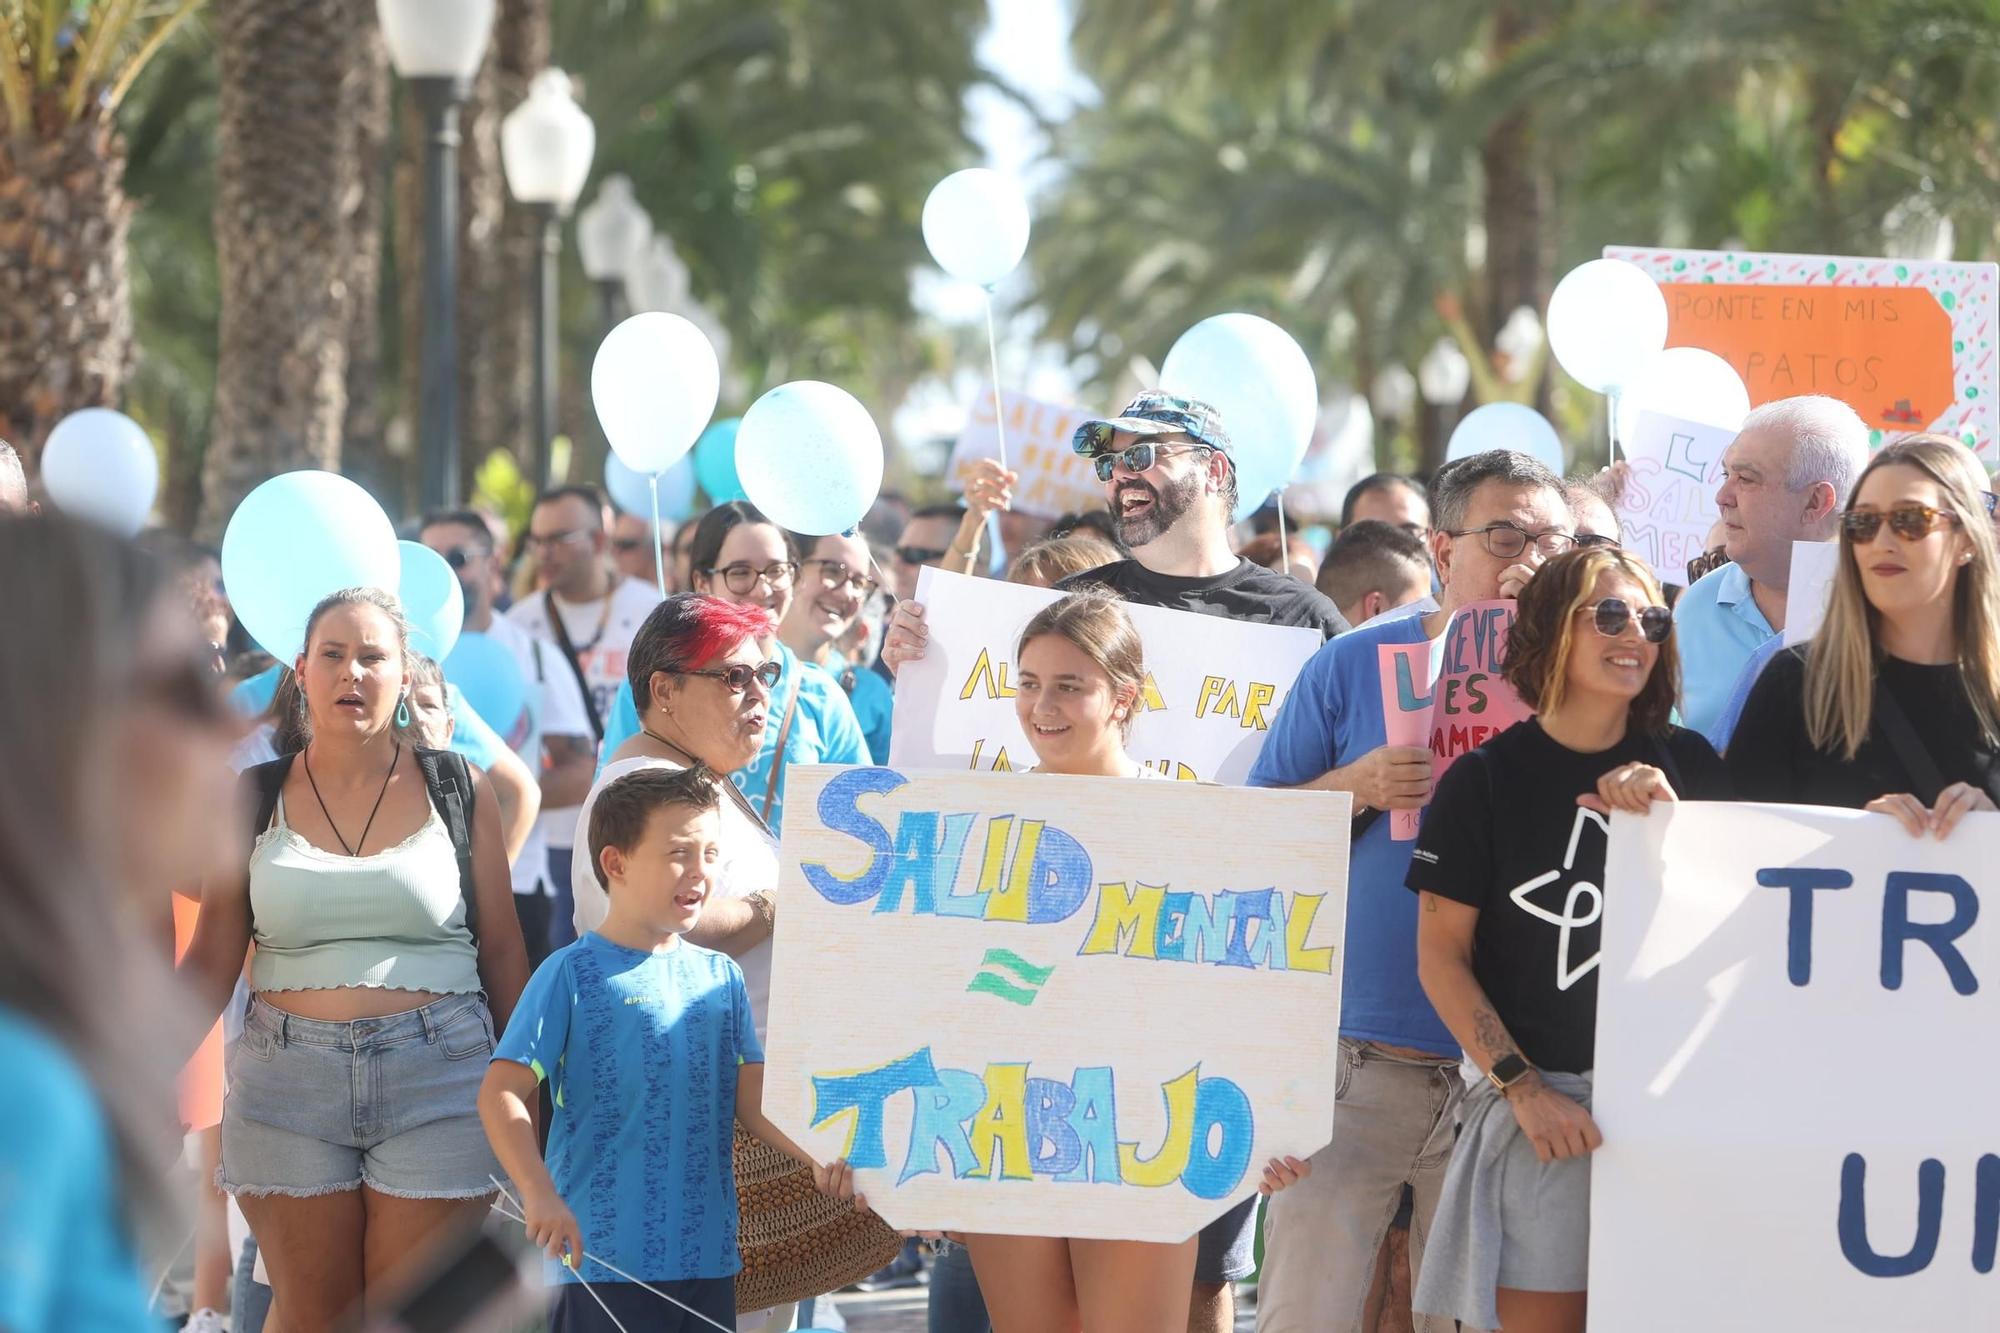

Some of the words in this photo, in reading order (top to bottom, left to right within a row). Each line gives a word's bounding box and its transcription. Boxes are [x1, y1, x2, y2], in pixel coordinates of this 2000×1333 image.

[1674, 292, 1765, 321] PONTE
[1782, 297, 1815, 321] EN
[1844, 299, 1899, 322] MIS
[1738, 351, 1882, 393] PATOS
[1622, 456, 1716, 527] SAL
[1195, 675, 1290, 731] PAR
[1445, 673, 1488, 715] ES
[800, 767, 1093, 925] SALUD
[1077, 881, 1334, 975] MENTAL
[1756, 867, 2000, 996] TR
[809, 1046, 1254, 1200] TRABAJO
